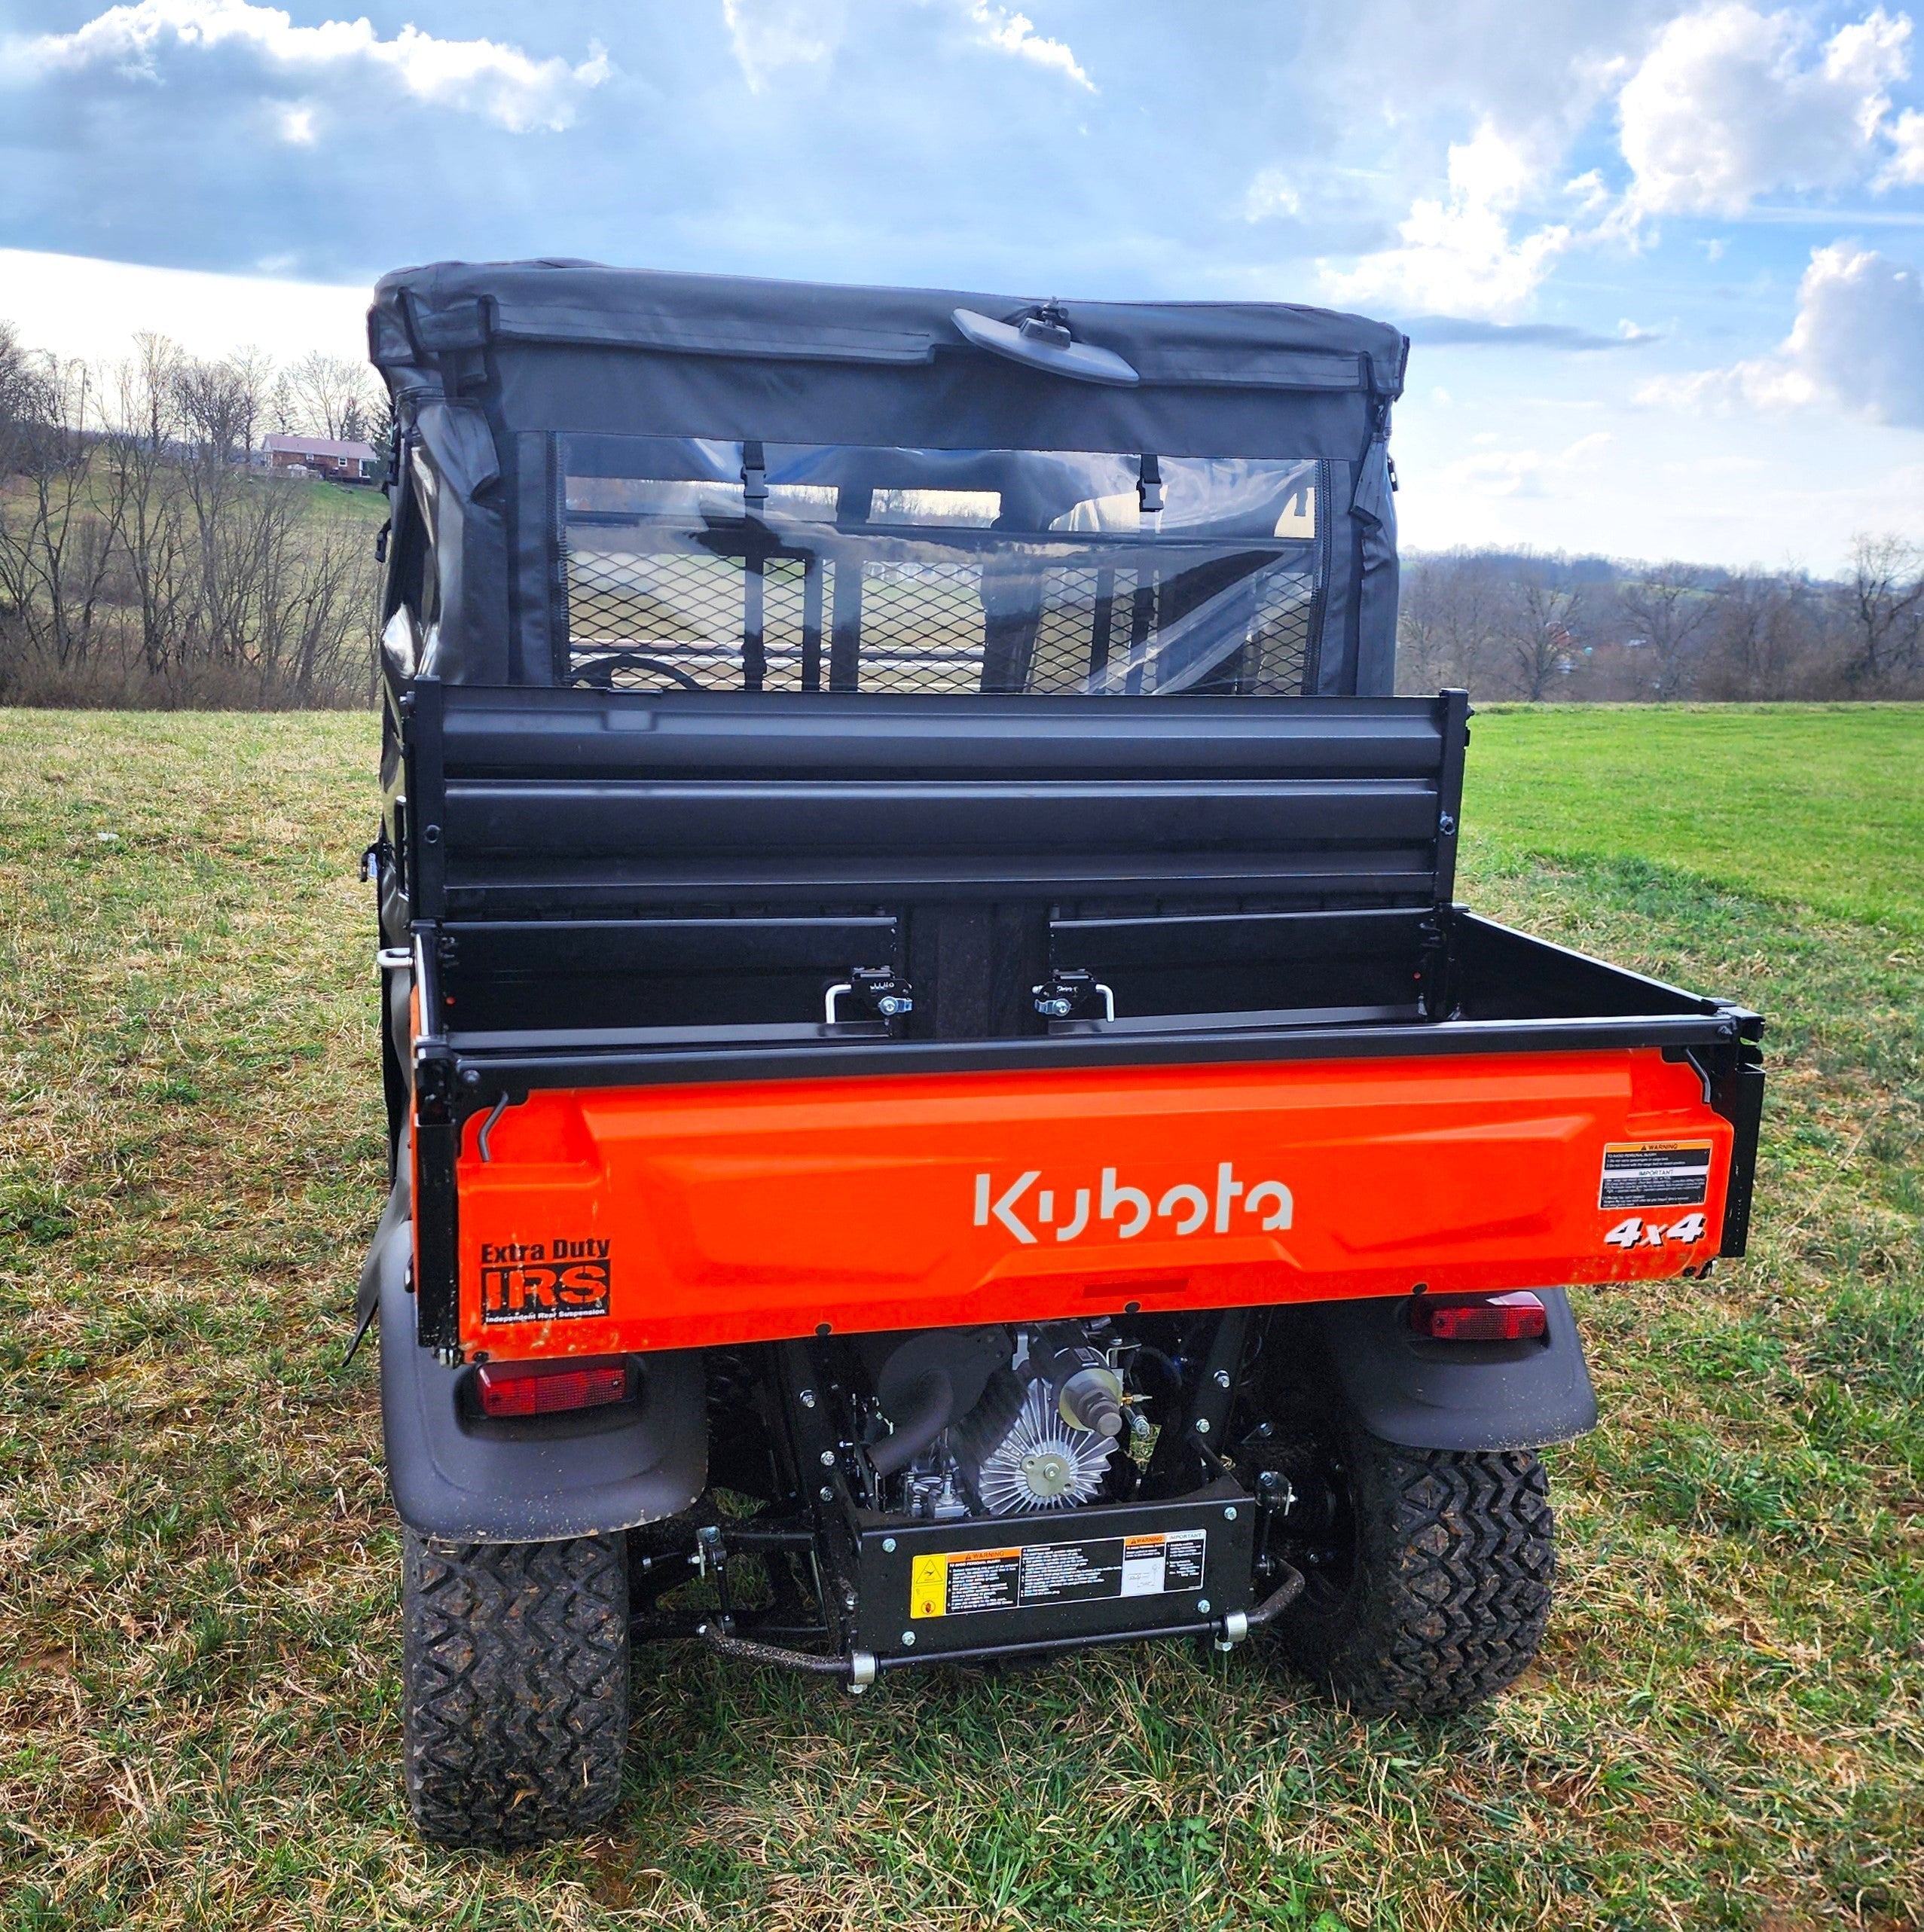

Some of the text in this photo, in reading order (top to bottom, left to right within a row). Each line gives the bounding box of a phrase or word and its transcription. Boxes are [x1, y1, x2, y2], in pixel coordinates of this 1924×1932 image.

[974, 1162, 1293, 1244] Kubota
[1603, 1213, 1706, 1250] 4x4
[481, 1238, 610, 1264] Extra Duty
[485, 1265, 607, 1311] IRS
[485, 1308, 606, 1323] Independent Rear Suspension
[973, 1551, 1004, 1559] WARNING
